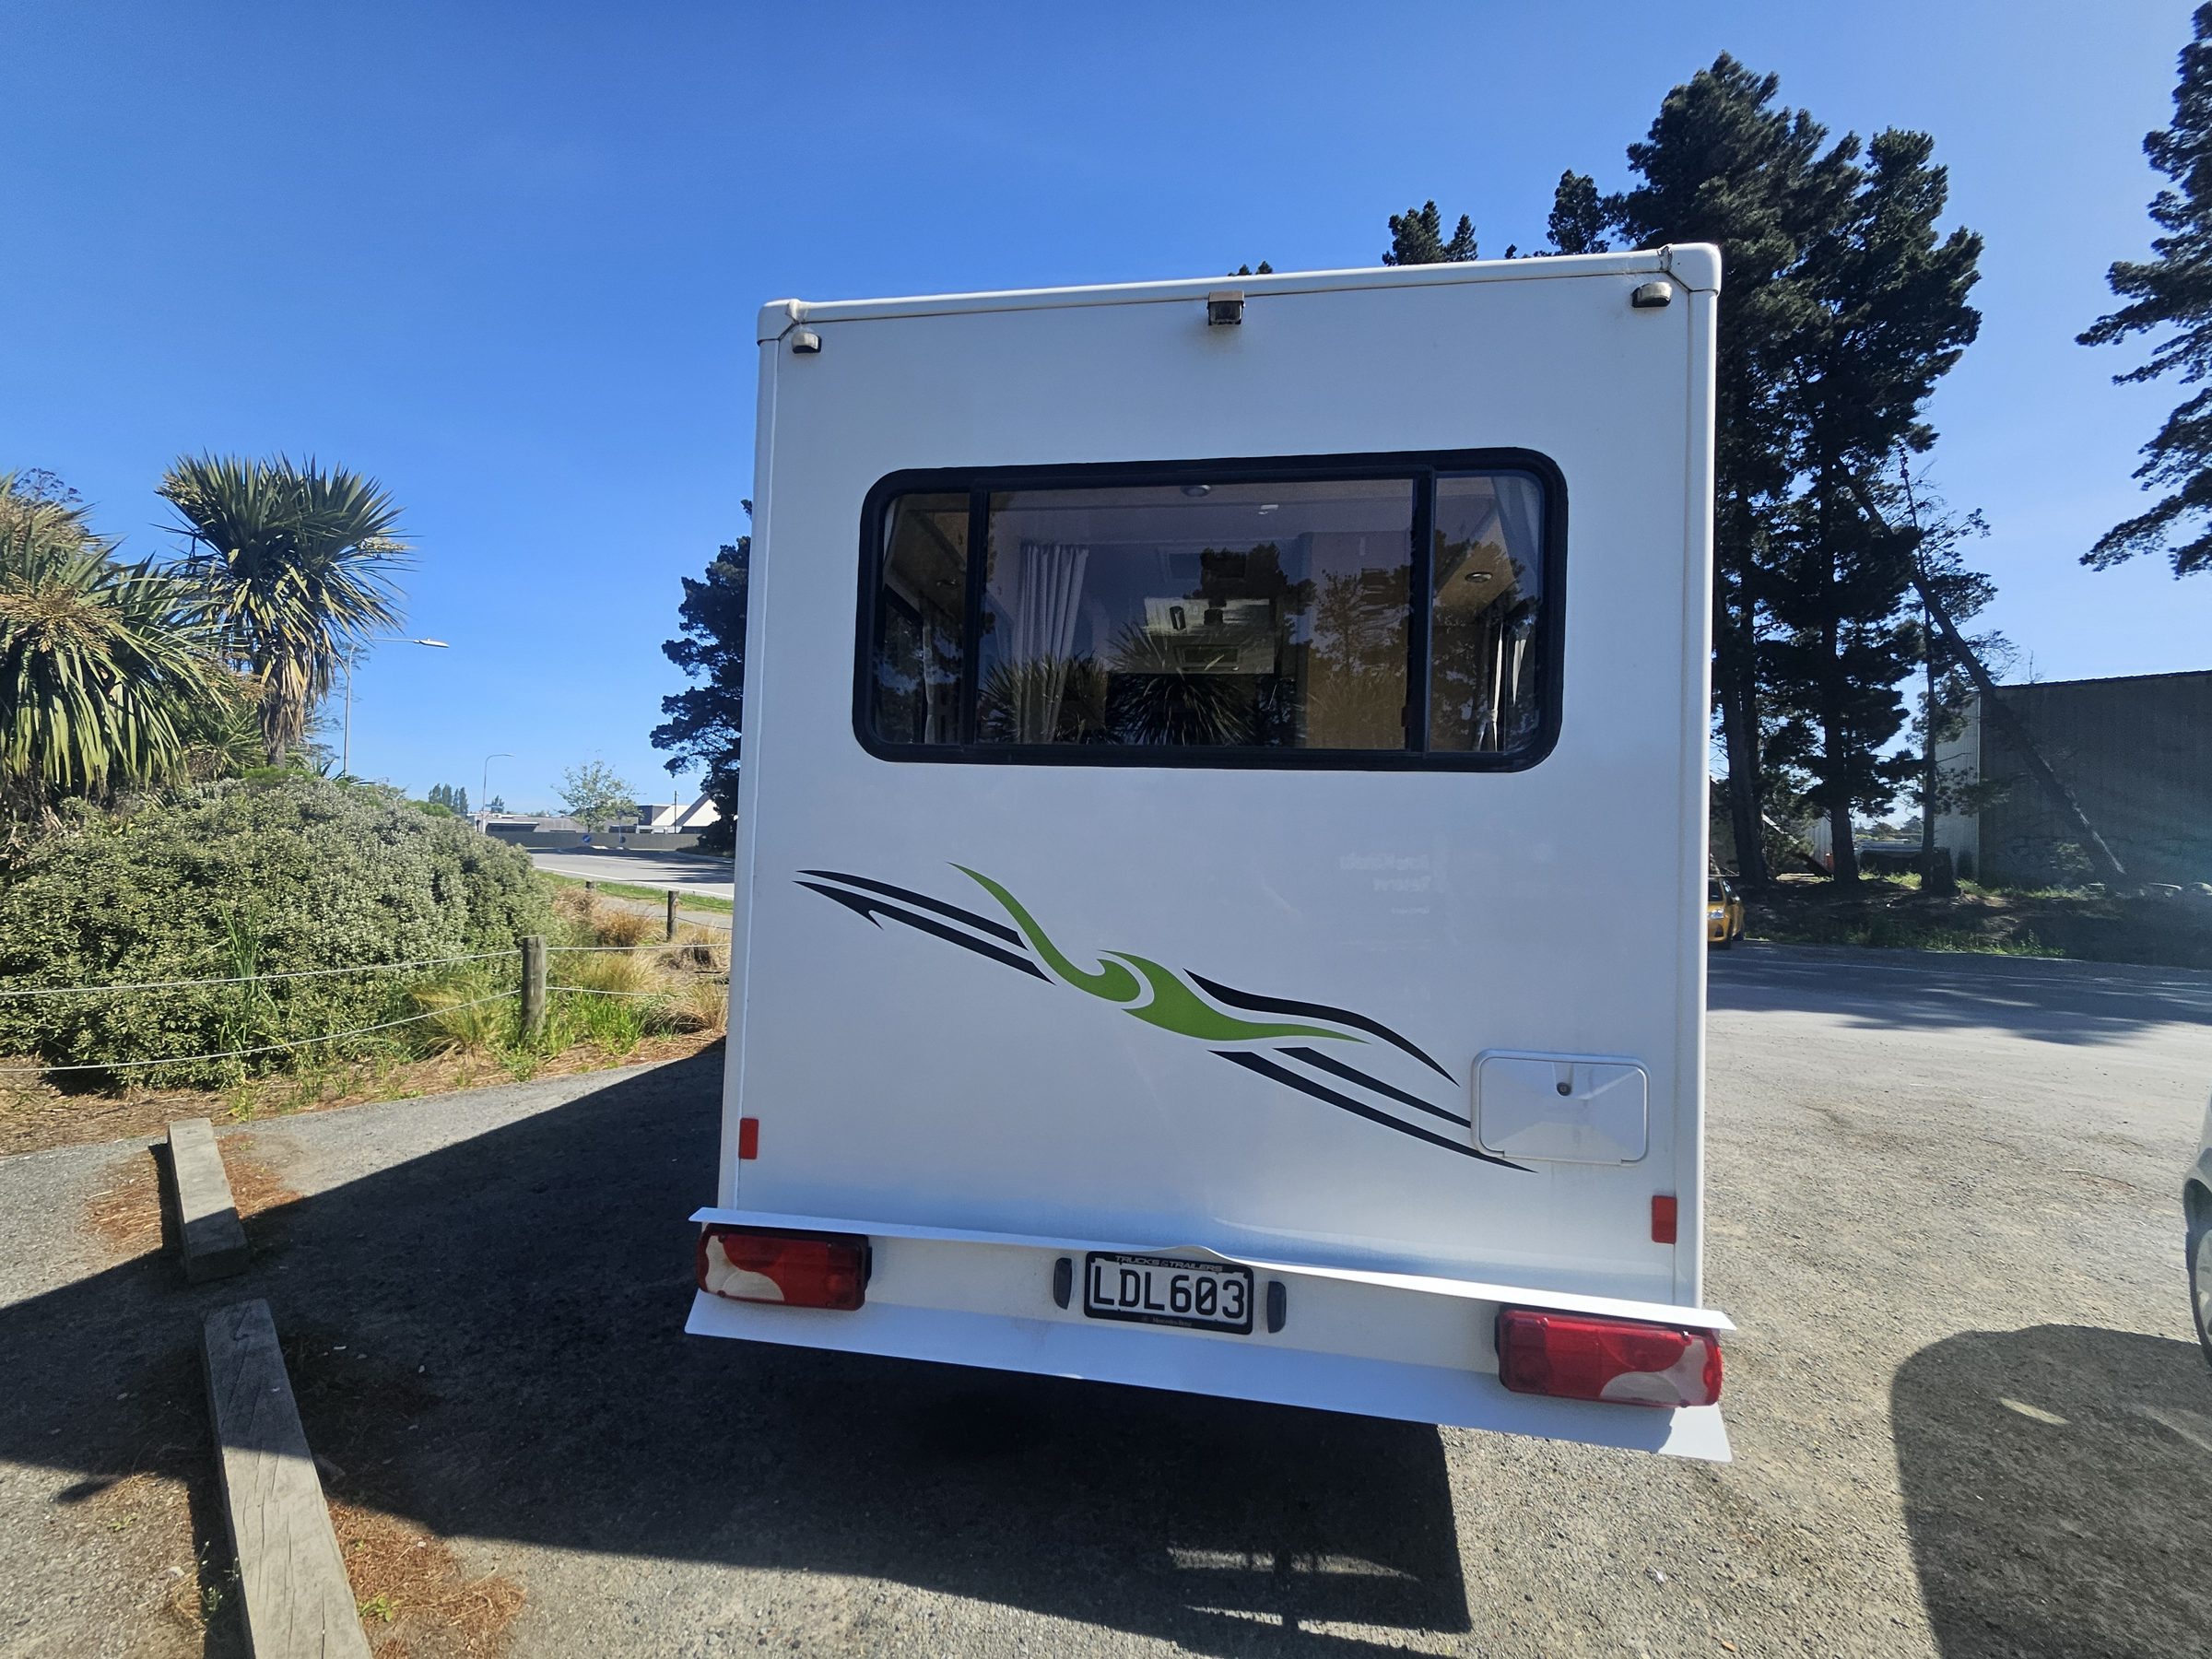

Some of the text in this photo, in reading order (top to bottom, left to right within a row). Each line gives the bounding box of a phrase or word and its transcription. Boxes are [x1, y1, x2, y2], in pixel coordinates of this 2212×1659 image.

[1115, 1255, 1159, 1266] TRUCKS
[1170, 1261, 1223, 1272] TRAILERS
[1094, 1265, 1244, 1319] LDL603
